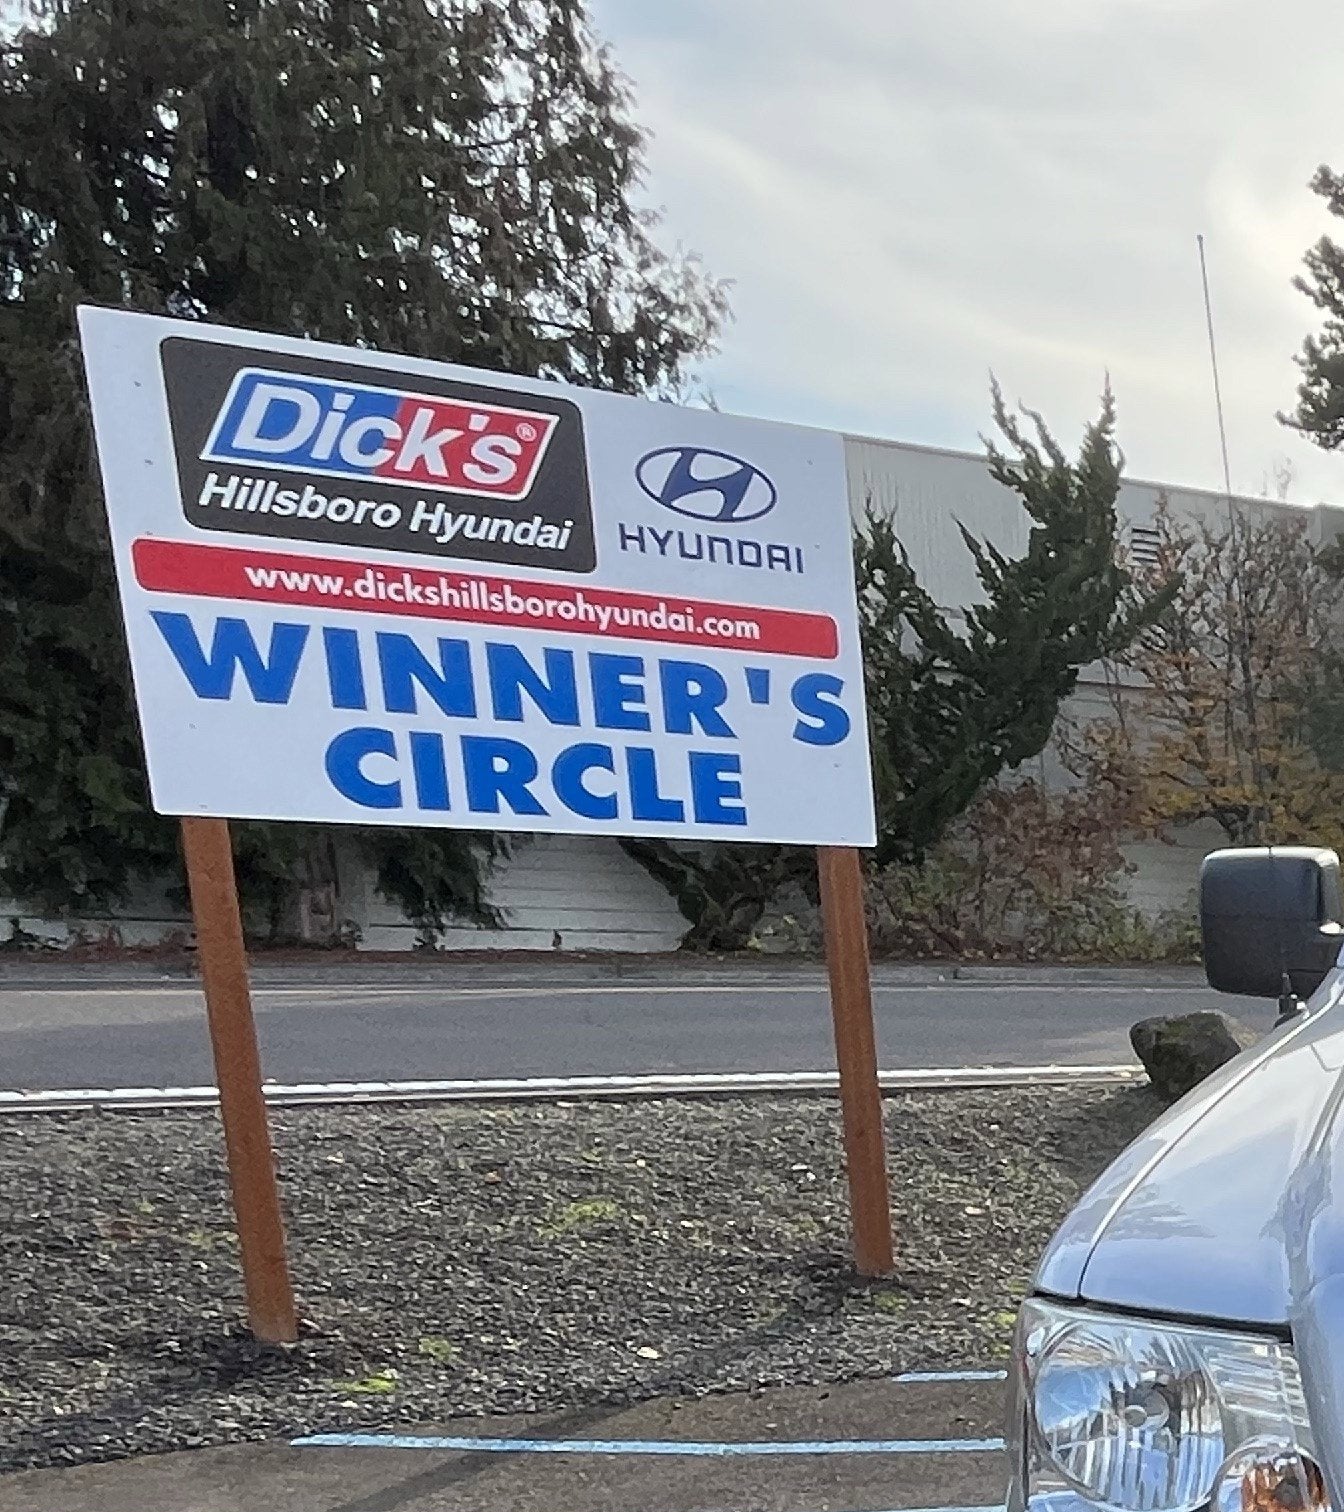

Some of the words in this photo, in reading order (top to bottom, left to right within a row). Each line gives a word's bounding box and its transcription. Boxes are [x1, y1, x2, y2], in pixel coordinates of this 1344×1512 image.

[198, 472, 401, 529] Hillsboro
[408, 501, 573, 551] Hyundai
[618, 522, 805, 574] HYUNDAI
[244, 562, 762, 641] www.dickshillsborohyundai.com
[148, 610, 852, 746] WINNER'S
[324, 726, 749, 826] CIRCLE
